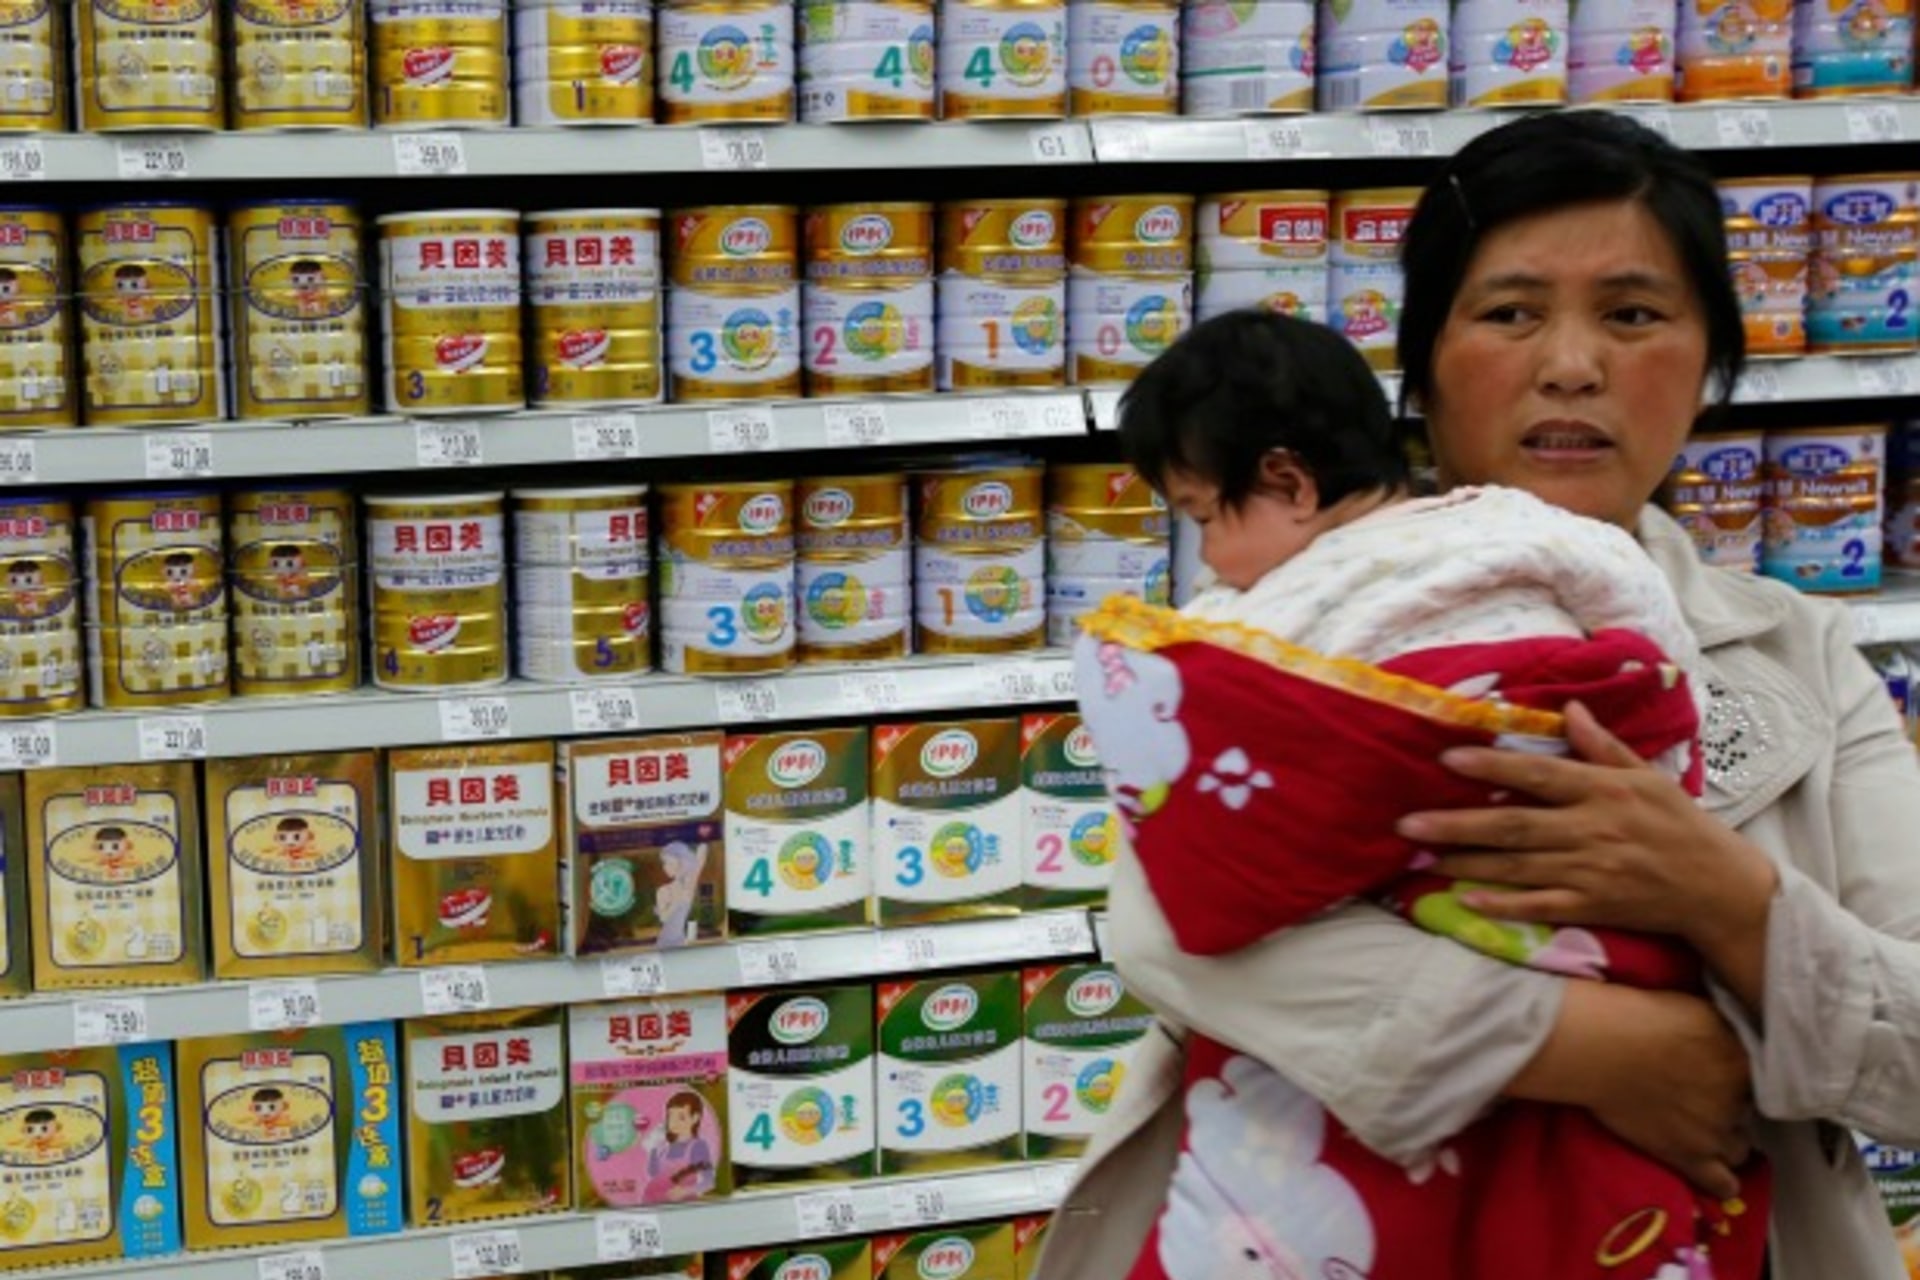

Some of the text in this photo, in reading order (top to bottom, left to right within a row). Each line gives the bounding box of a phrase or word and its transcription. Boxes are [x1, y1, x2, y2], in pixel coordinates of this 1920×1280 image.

[670, 52, 693, 94] 4
[874, 46, 902, 86] 4
[965, 46, 995, 86] 4
[1092, 56, 1114, 88] 0
[1039, 137, 1066, 156] G1
[419, 240, 508, 270] 貝因美
[544, 236, 635, 268] 貝因美
[1885, 288, 1909, 328] 2
[690, 331, 717, 373] 3
[813, 326, 837, 365] 2
[981, 320, 998, 359] 1
[1097, 325, 1120, 355] 0
[407, 371, 425, 400] 3
[395, 522, 483, 554] 貝因美
[1841, 538, 1866, 577] 2
[706, 605, 738, 647] 3
[937, 588, 954, 626] 1
[384, 648, 399, 676] 4
[595, 636, 615, 668] 5
[608, 752, 690, 787] 貝因美
[425, 774, 520, 807] 貝因美
[895, 845, 924, 887] 3
[1035, 833, 1063, 873] 2
[742, 857, 774, 897] 4
[410, 933, 424, 960] 1
[608, 1010, 692, 1043] 貝因美
[441, 1038, 531, 1072] 貝因美
[896, 1098, 925, 1138] 3
[1042, 1083, 1071, 1122] 2
[743, 1111, 776, 1151] 4
[426, 1196, 442, 1221] 2
